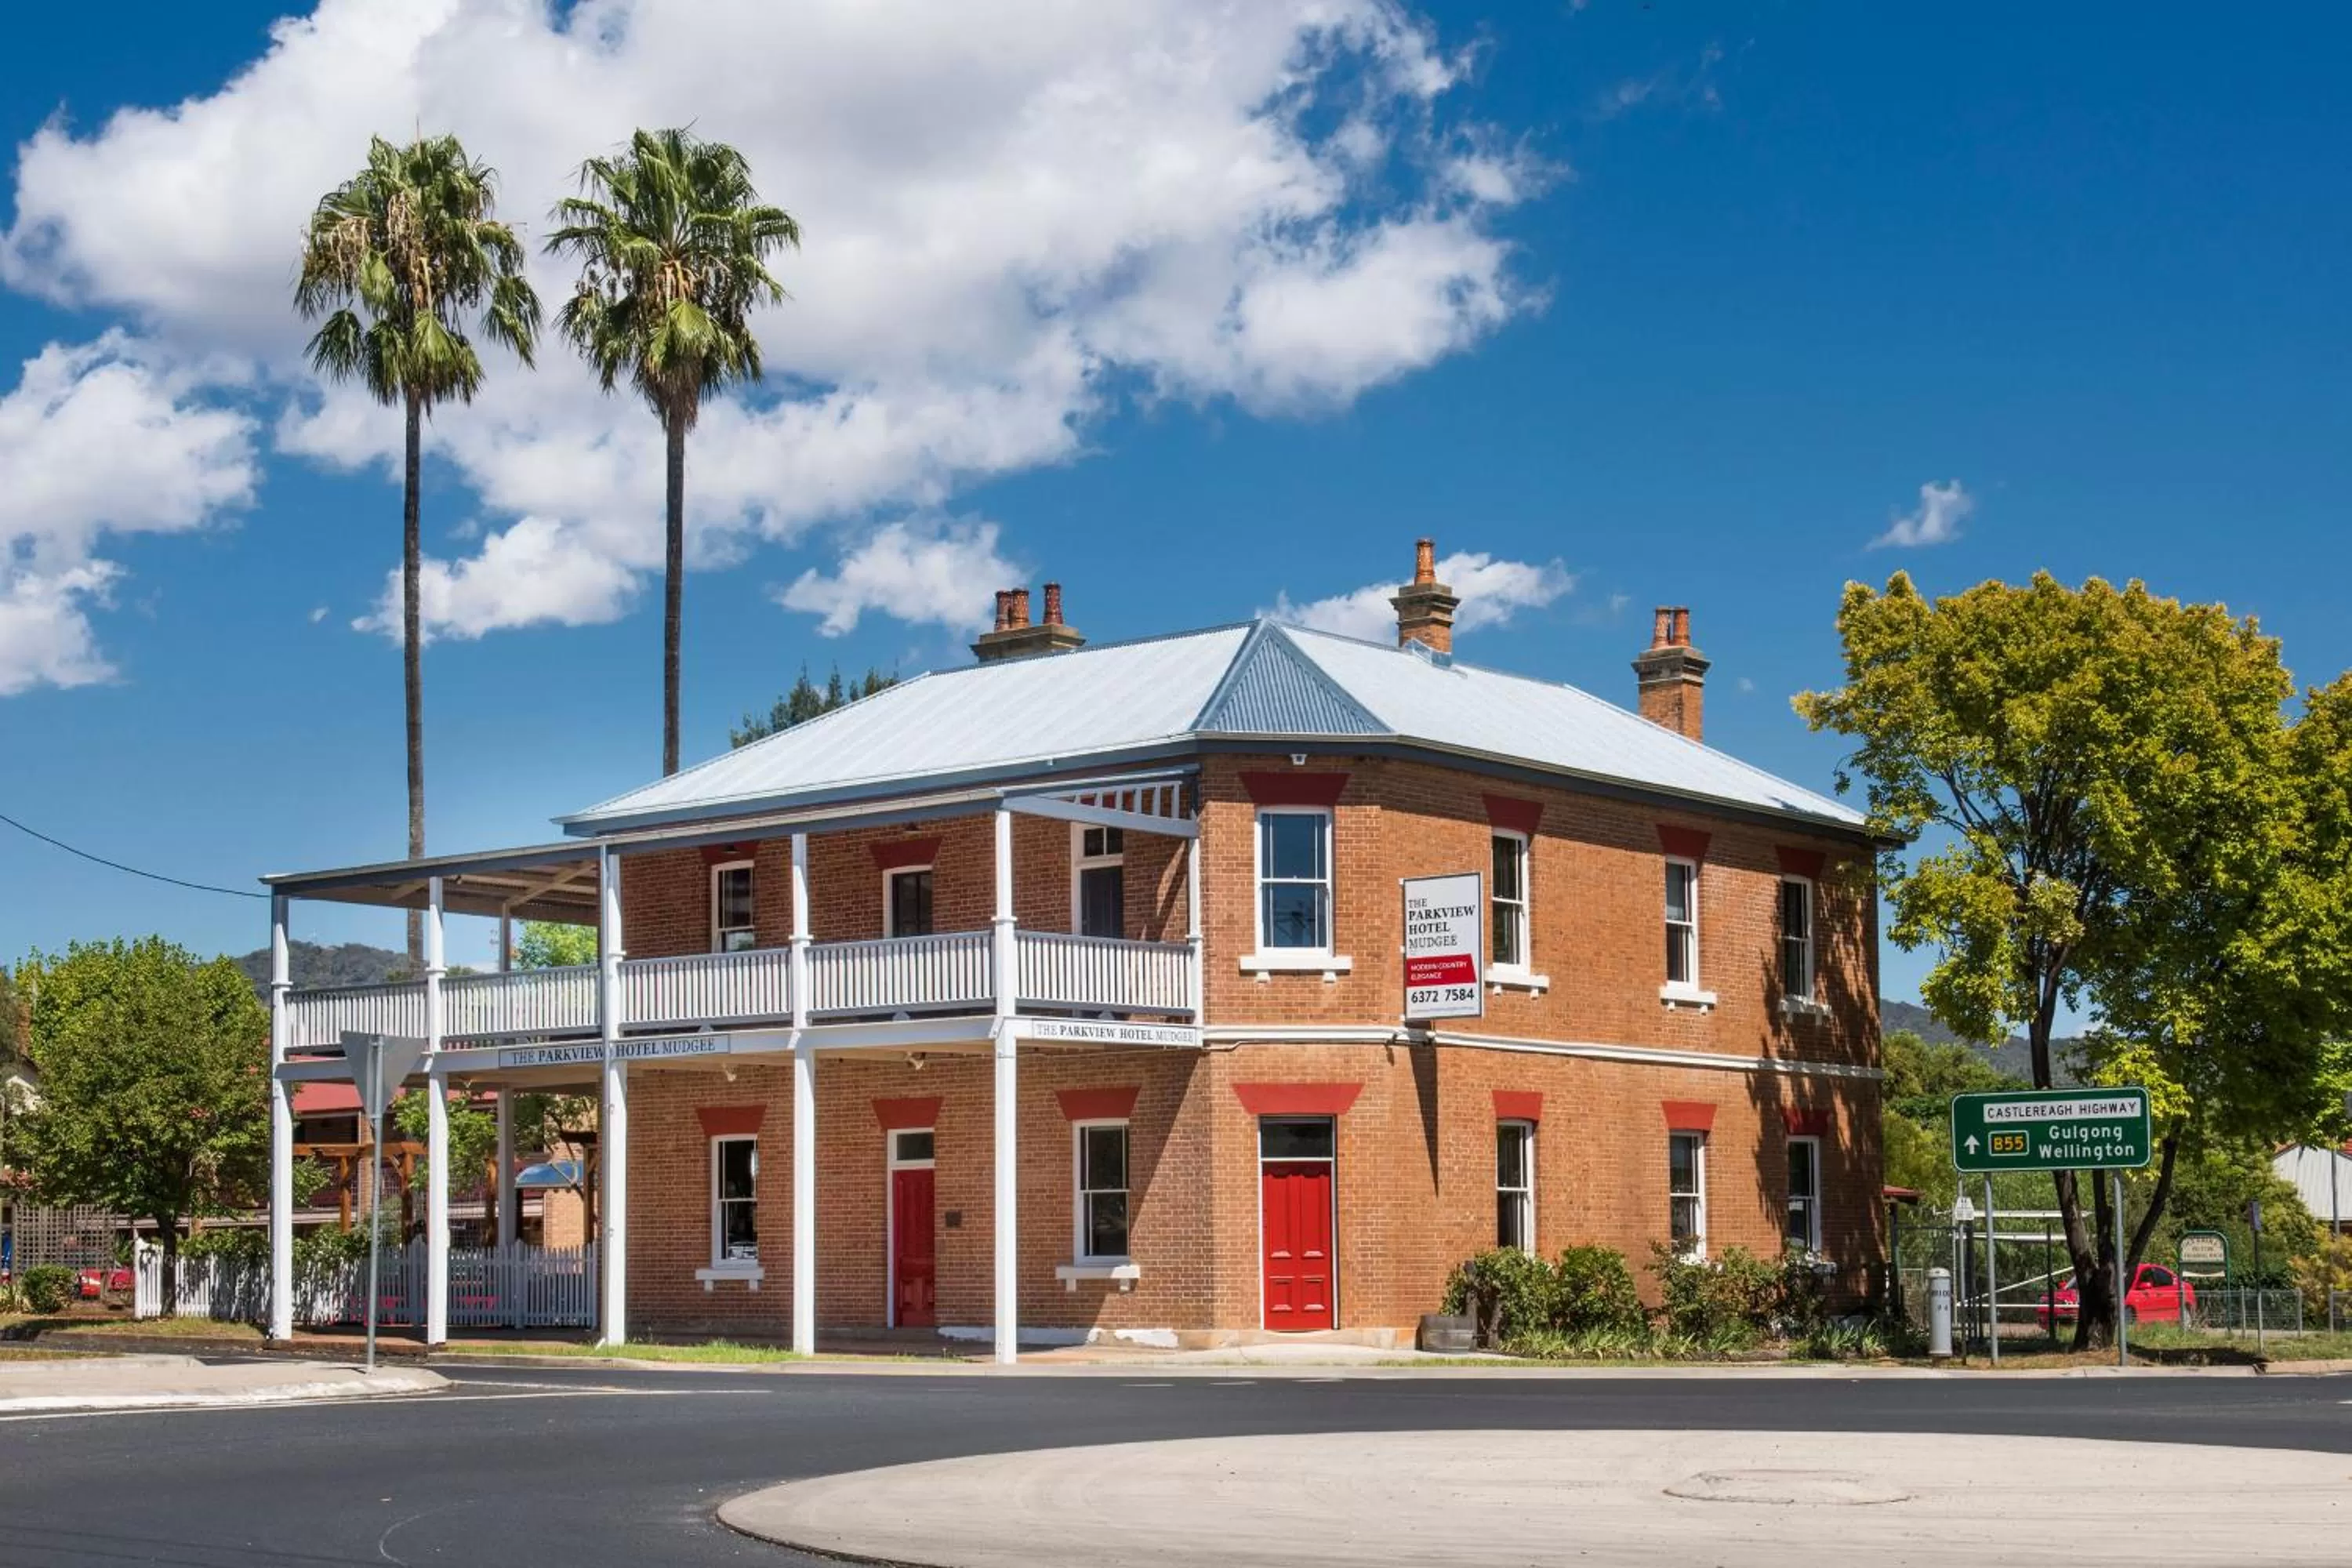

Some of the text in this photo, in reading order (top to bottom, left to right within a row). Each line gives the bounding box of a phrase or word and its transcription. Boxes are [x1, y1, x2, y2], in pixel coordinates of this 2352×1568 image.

[1408, 898, 1427, 909] THE
[1409, 905, 1475, 920] PARKVIEW
[1409, 922, 1450, 935] HOTEL
[1409, 935, 1457, 949] MUDGEE
[1411, 988, 1474, 1004] 6372 7584
[1037, 1025, 1193, 1043] THE PARKVIEW HOTEL MUDGEE
[514, 1049, 535, 1065] THE
[615, 1041, 659, 1058] HOTEL
[662, 1037, 716, 1054] MUDGEE
[1987, 1101, 2136, 1119] CASTLEREAGH HIGHWAY
[2049, 1125, 2123, 1142] Gulgong
[1993, 1136, 2024, 1151] B55
[2039, 1143, 2135, 1160] Wellington
